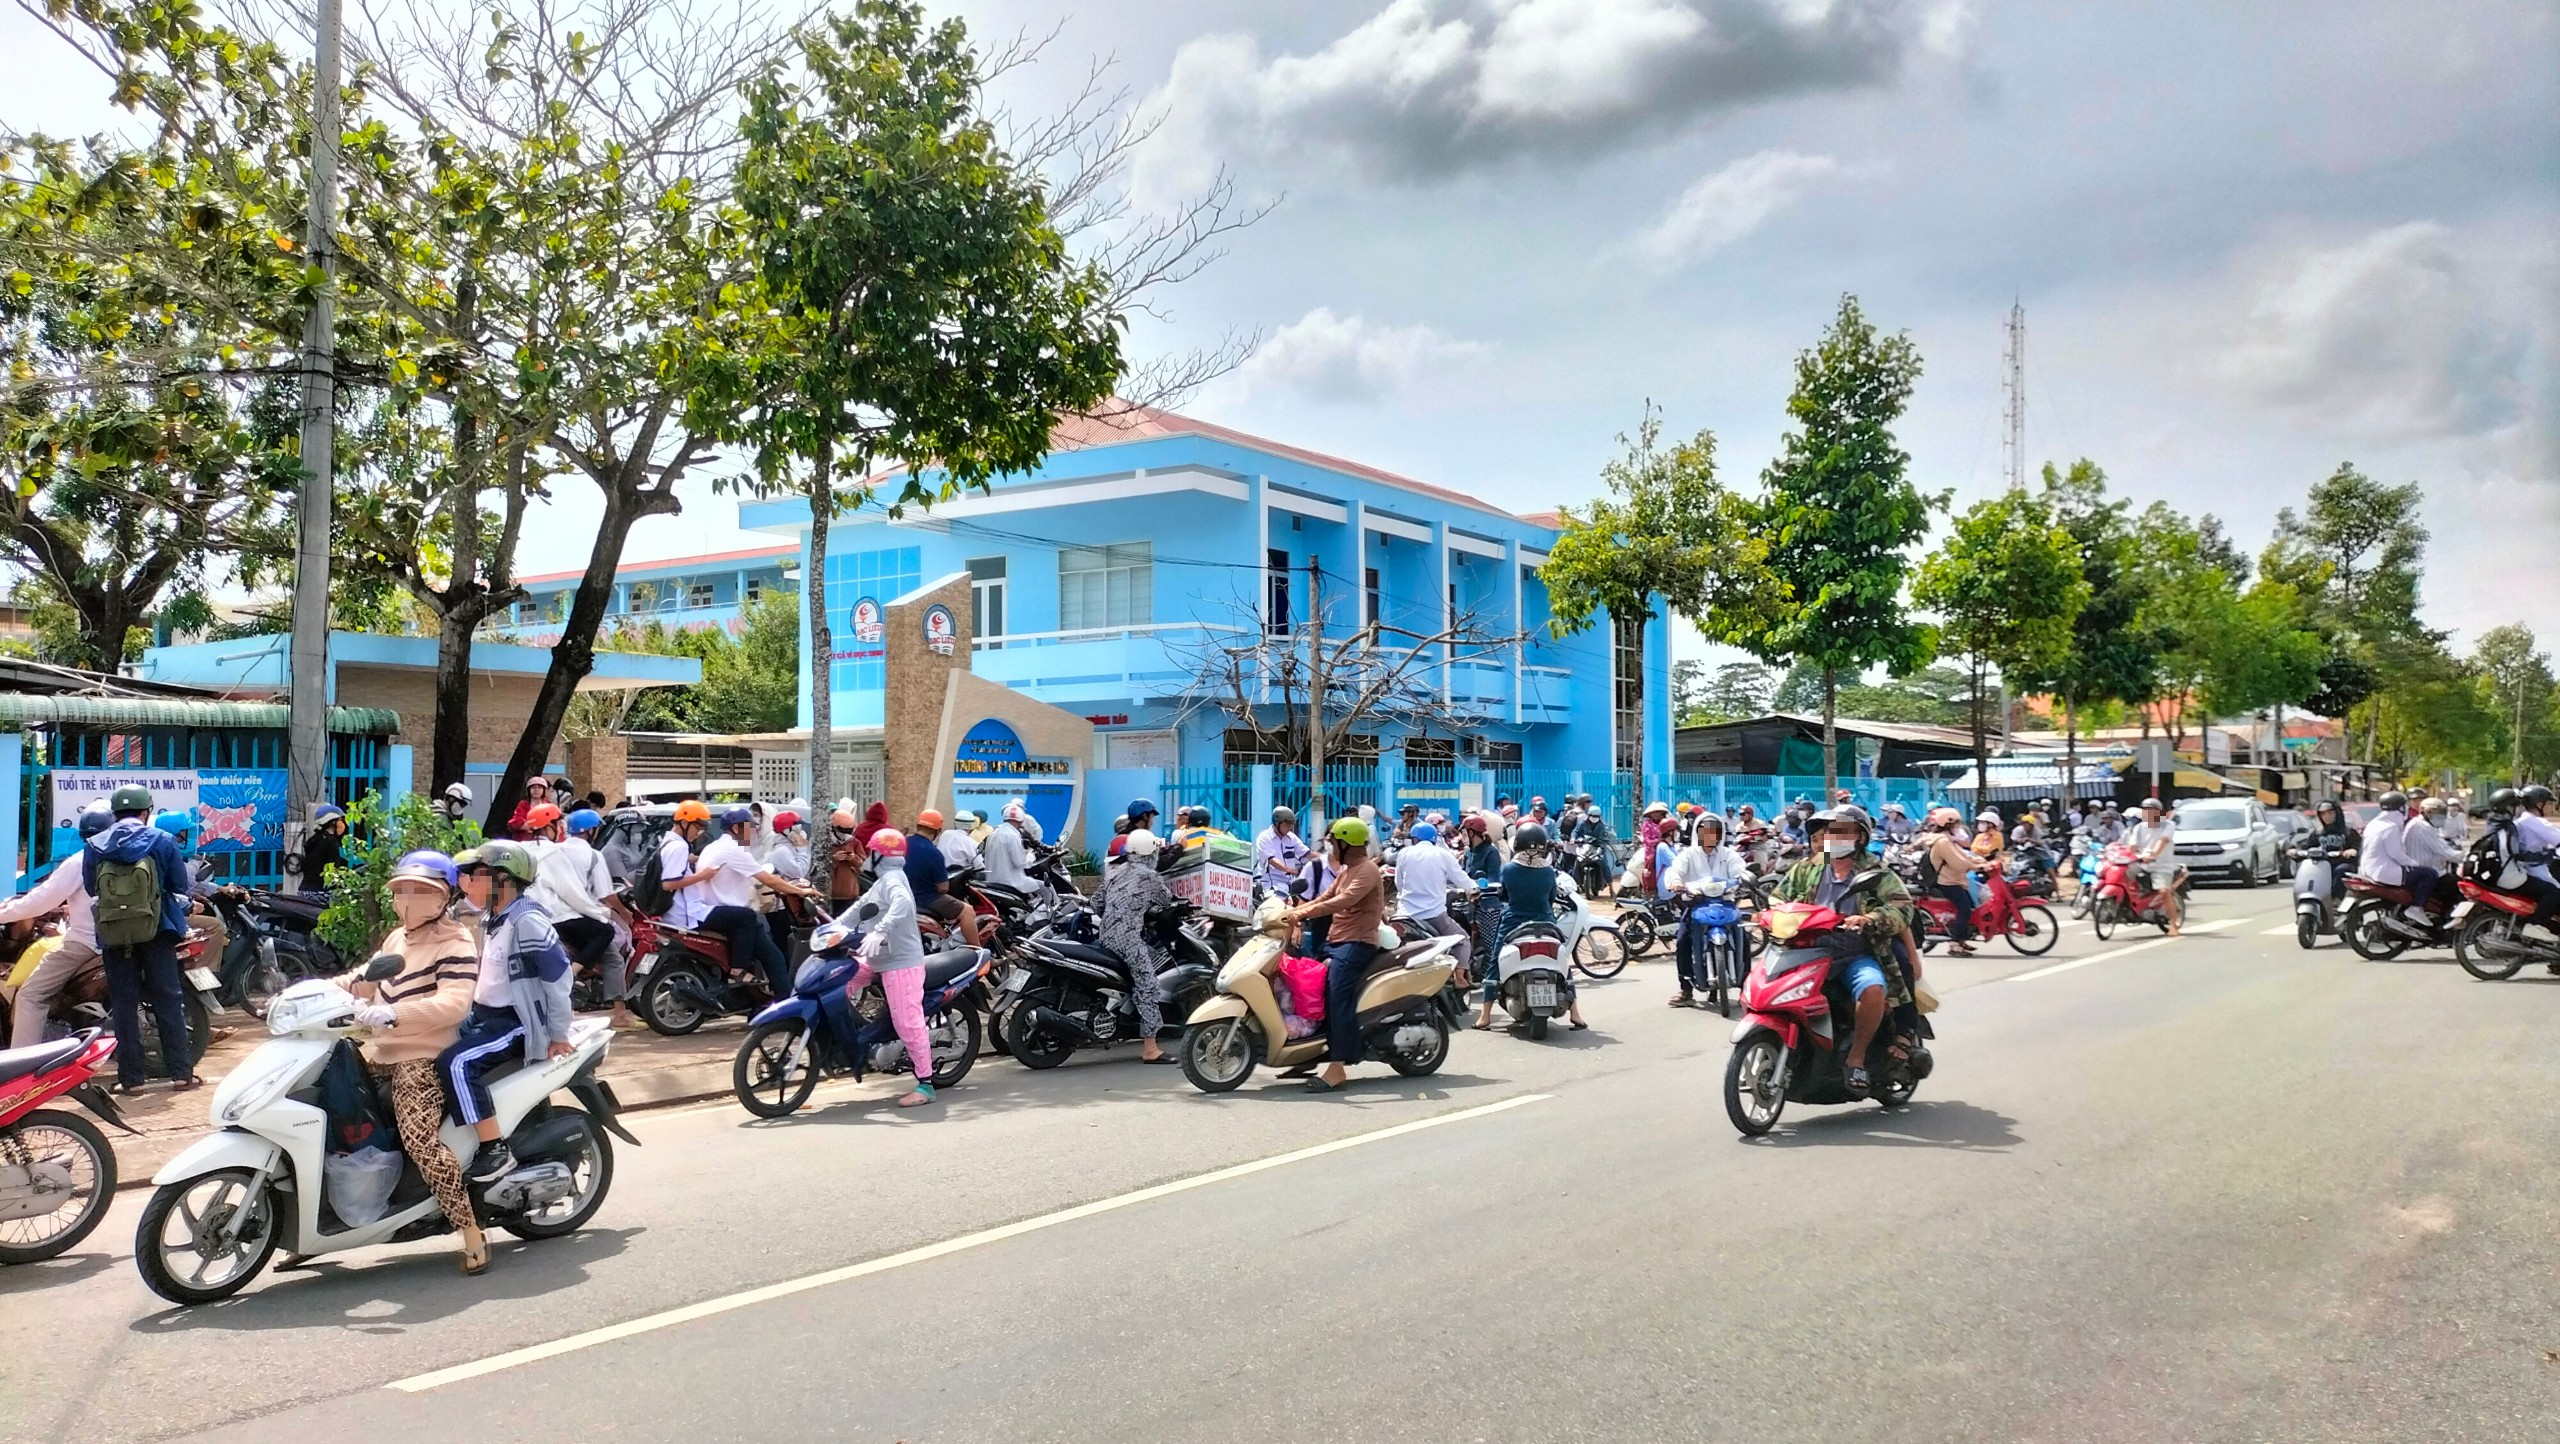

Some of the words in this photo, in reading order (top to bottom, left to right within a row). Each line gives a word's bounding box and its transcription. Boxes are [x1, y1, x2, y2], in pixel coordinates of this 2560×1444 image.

[57, 774, 79, 791] TUỔI
[80, 775, 97, 791] TRẺ
[100, 778, 117, 791] HÃY
[150, 779, 161, 790] XA
[163, 779, 175, 790] MA
[177, 776, 194, 790] TÚY
[292, 1119, 321, 1128] HONDA
